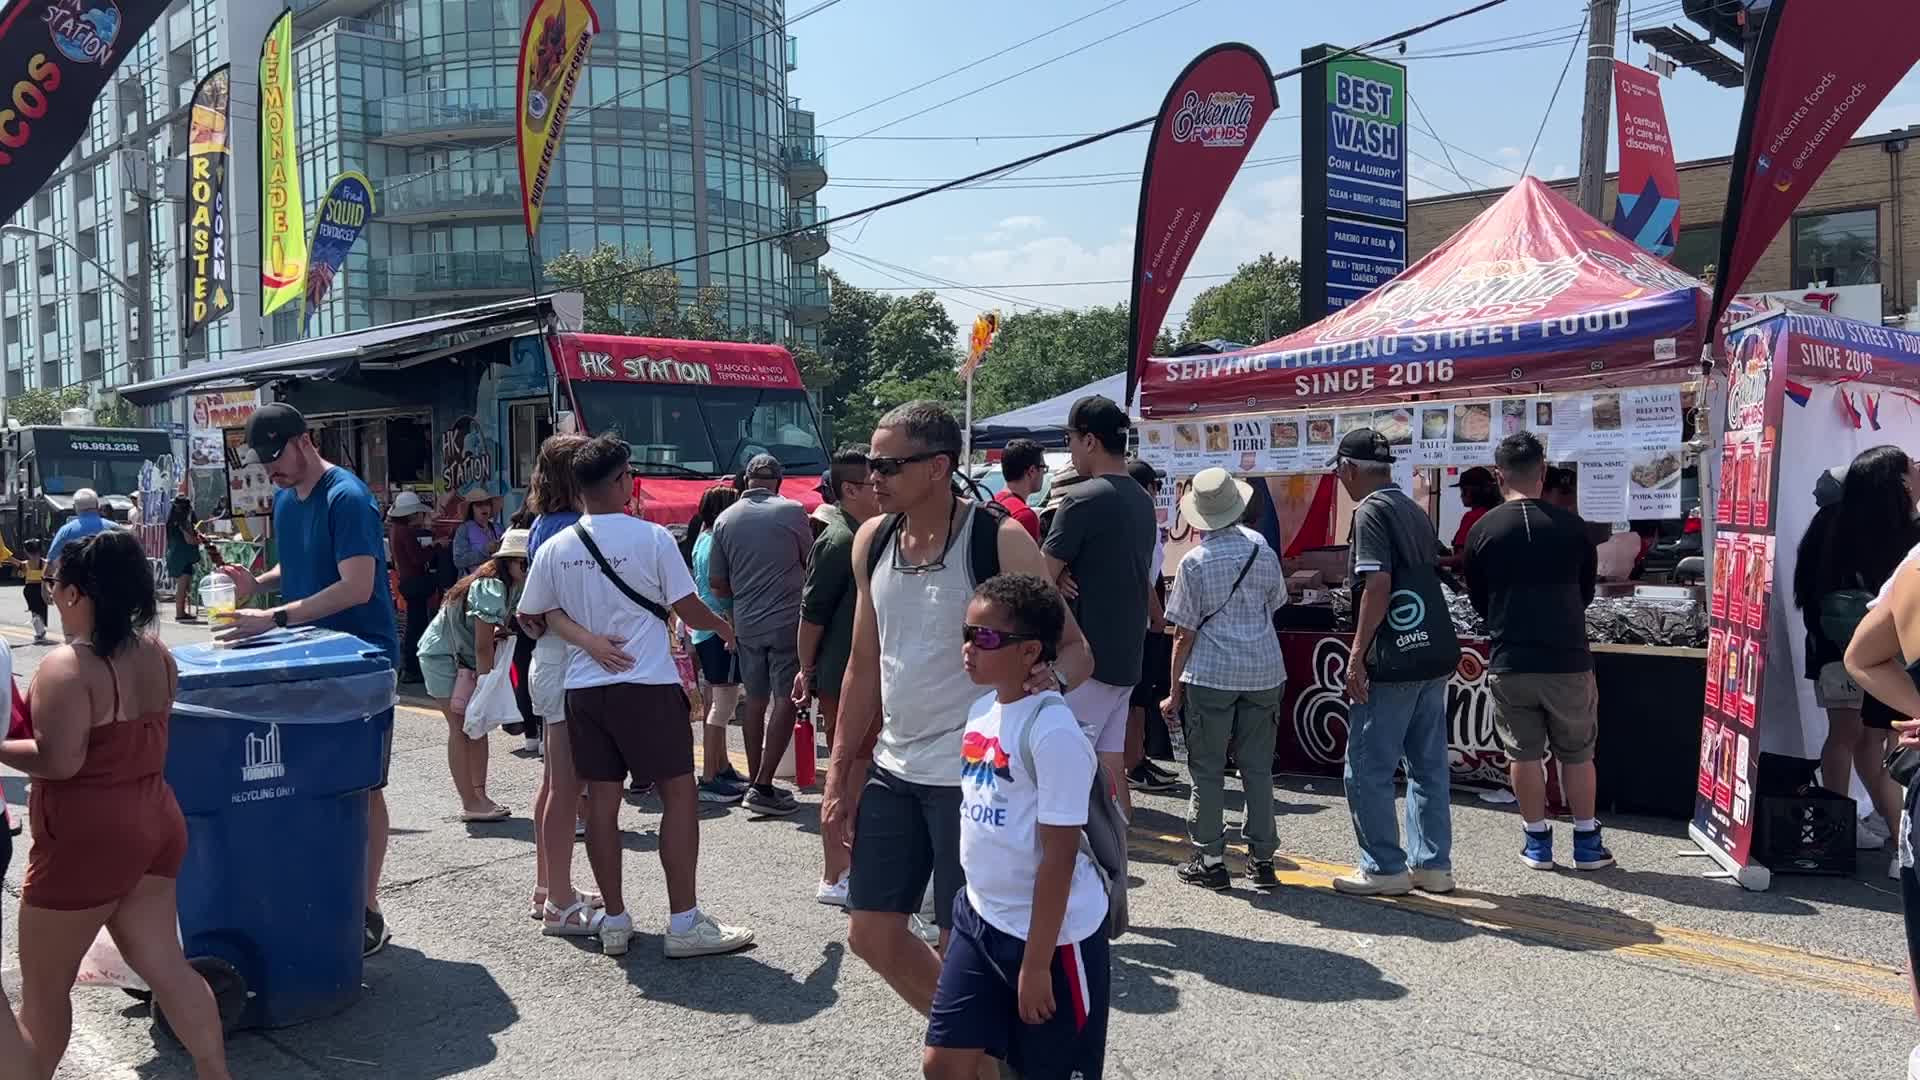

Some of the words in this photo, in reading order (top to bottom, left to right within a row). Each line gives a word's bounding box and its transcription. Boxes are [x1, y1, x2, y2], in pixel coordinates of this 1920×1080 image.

[42, 5, 114, 66] STATION
[0, 53, 61, 166] COS
[1336, 71, 1393, 119] BEST
[1172, 90, 1255, 143] Eskenita
[1625, 112, 1632, 123] A
[1633, 116, 1661, 131] century
[1770, 106, 1809, 154] eskenita
[1804, 71, 1836, 106] foods
[1792, 81, 1867, 170] @eskenitafoods
[263, 38, 289, 233] LEMONADE
[1332, 111, 1398, 160] WASH
[1625, 125, 1634, 136] of
[1636, 129, 1654, 140] care
[1654, 132, 1668, 144] and
[1328, 155, 1352, 172] COIN
[326, 199, 365, 228] SQUID
[1328, 188, 1349, 200] CLEAN
[1353, 192, 1374, 204] BRIGHT
[1379, 197, 1402, 209] SECURE
[190, 156, 212, 323] ROASTED
[213, 191, 226, 281] CORN
[1151, 233, 1172, 269] eskenita
[1168, 206, 1185, 234] foods
[1334, 231, 1360, 244] PARKING
[1361, 236, 1369, 245] AT
[1371, 238, 1387, 249] REAR
[1351, 261, 1371, 273] TRIPLE
[1375, 265, 1398, 276] DOUBLE
[1351, 273, 1378, 284] LOADERS
[1327, 296, 1343, 306] FREE
[1166, 356, 1268, 382] SERVING
[1280, 336, 1398, 369] FILIPINO
[1412, 319, 1522, 352] STREET
[1541, 308, 1631, 339] FOOD
[1788, 314, 1844, 341] FILIPINO
[1846, 322, 1894, 349] STREET
[577, 350, 616, 378] HK
[621, 356, 713, 385] STATION
[1801, 342, 1841, 369] SINCE
[1845, 350, 1873, 373] 2016
[1294, 366, 1376, 396] SINCE
[1387, 359, 1455, 387] 2016
[442, 429, 461, 458] HK
[1232, 438, 1267, 451] HERE
[1233, 421, 1262, 437] PAY
[443, 455, 490, 489] STATION
[1395, 629, 1429, 648] davis
[240, 763, 285, 782] TORONTO
[231, 787, 275, 803] RECYCLING
